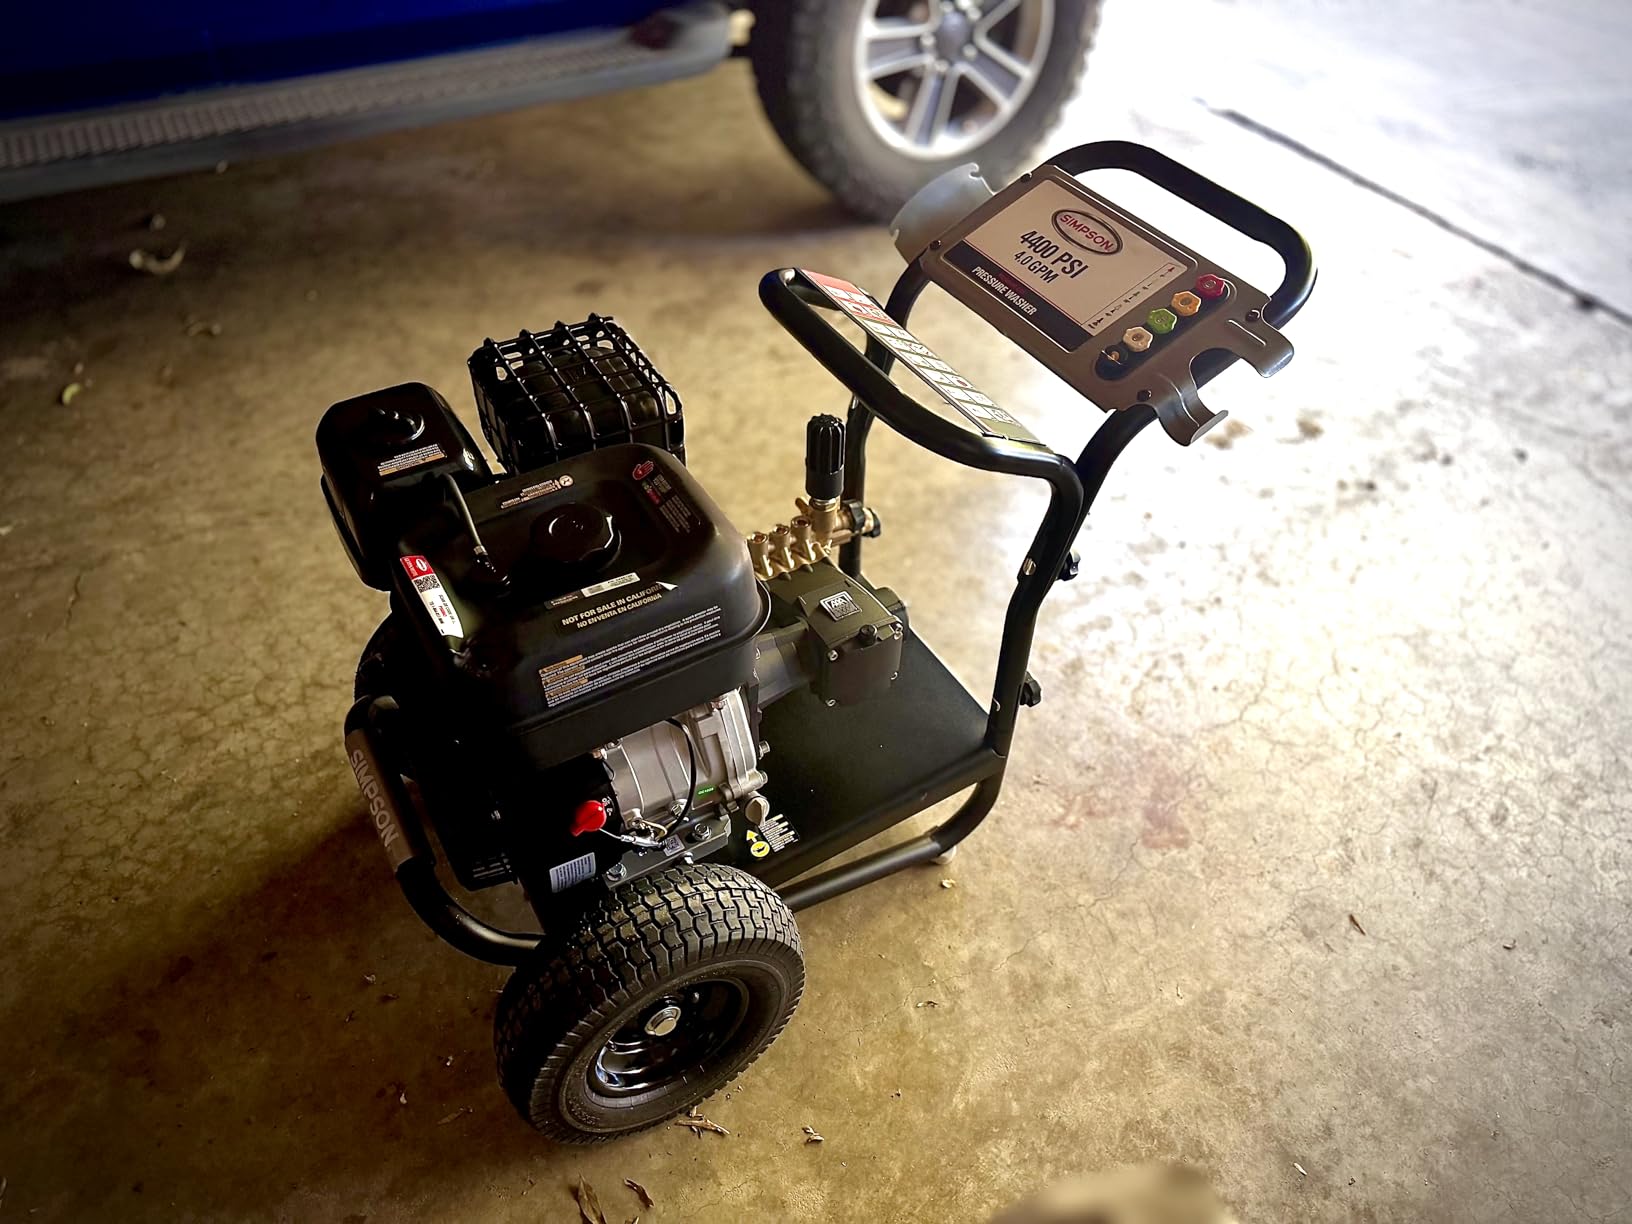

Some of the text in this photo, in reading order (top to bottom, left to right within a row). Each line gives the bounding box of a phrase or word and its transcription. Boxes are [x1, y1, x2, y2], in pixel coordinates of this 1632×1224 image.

[1020, 230, 1089, 279] 4400 PSI
[1060, 213, 1114, 253] SIMPSON
[1014, 251, 1059, 284] 4.0 GPM
[972, 266, 1037, 316] PRESSURE WASHER
[561, 614, 580, 626] NOT
[579, 608, 597, 620] FOR
[596, 601, 617, 614] SALE
[616, 598, 626, 606] IN
[625, 583, 664, 603] CALIFORN
[576, 593, 662, 629] NO EN VENTA EN CALIFORNIA
[350, 749, 400, 848] SIMPSON
